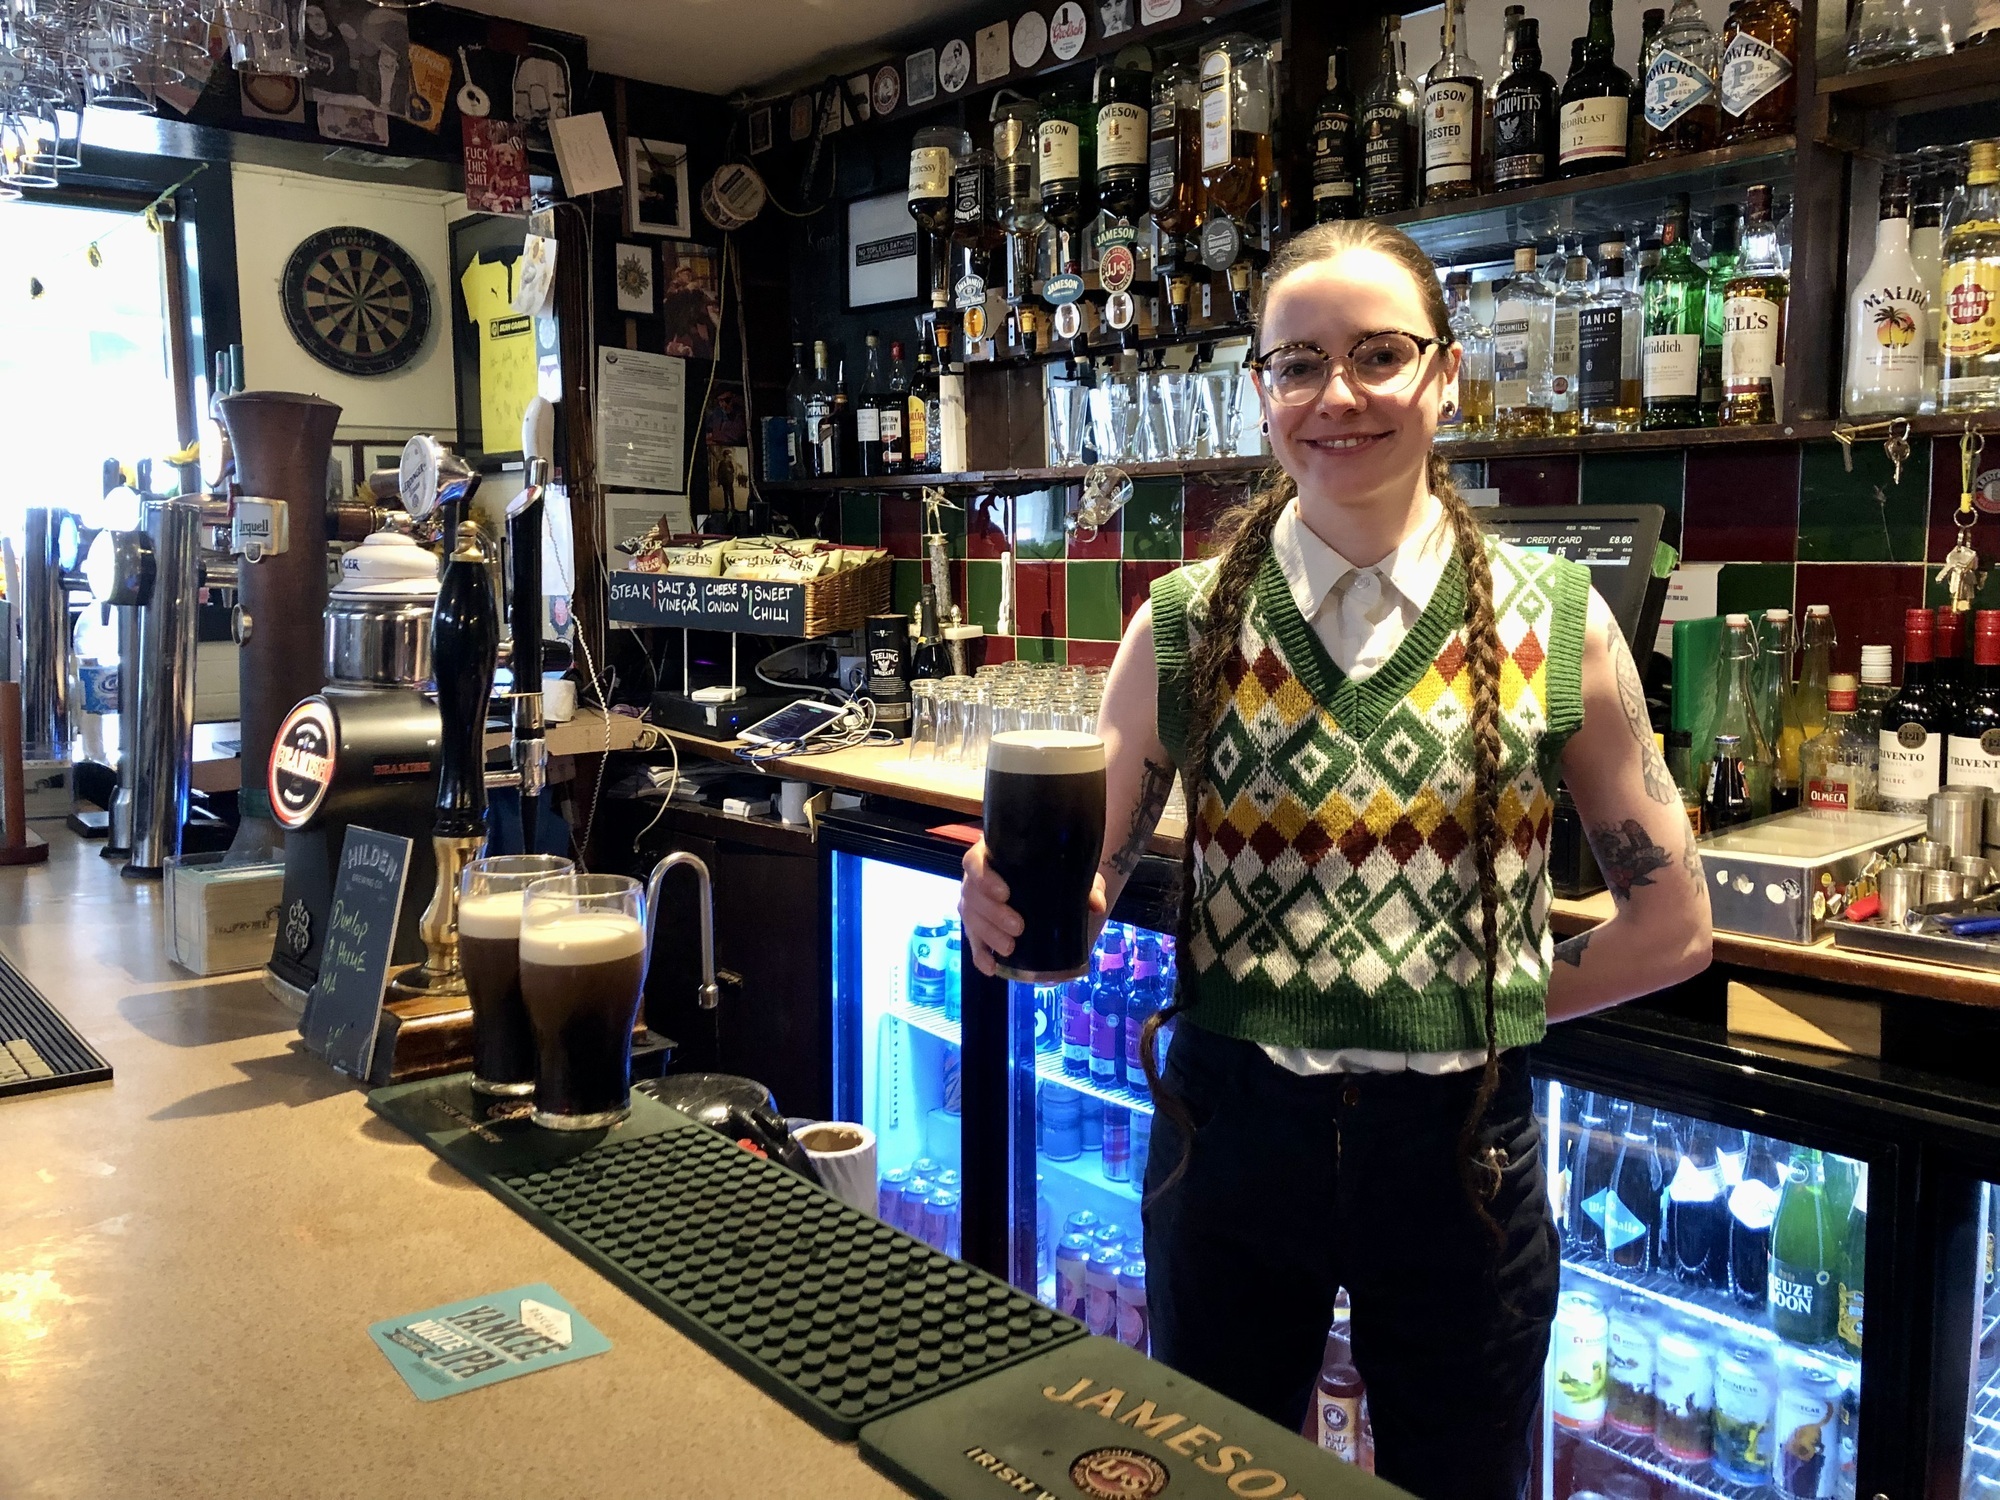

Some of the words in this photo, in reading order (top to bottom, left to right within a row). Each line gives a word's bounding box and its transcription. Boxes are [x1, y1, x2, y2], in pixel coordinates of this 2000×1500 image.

[1052, 18, 1085, 44] Grolsch
[1731, 60, 1755, 90] P
[1426, 90, 1466, 105] AMESON
[1655, 77, 1678, 105] P
[1494, 94, 1541, 119] LACKPITTS
[1100, 107, 1139, 123] AMESON
[1363, 107, 1400, 126] AMESON
[1040, 125, 1069, 138] MESON
[1426, 125, 1461, 141] CRESTED
[1366, 139, 1389, 153] BLACK
[1573, 136, 1583, 146] 12
[465, 147, 488, 160] FUCK
[467, 160, 487, 173] THIS
[911, 164, 936, 174] ennessy
[468, 173, 487, 186] SHIT
[1096, 227, 1135, 246] JAMESON
[867, 244, 889, 255] TOPLESS
[1047, 279, 1079, 295] JAMESON
[1863, 286, 1927, 312] MALIBU
[1950, 305, 1983, 318] Club
[1495, 322, 1528, 333] BUSHMILLS
[1723, 312, 1768, 334] BELL'S
[807, 406, 829, 415] MPARI
[1526, 536, 1557, 544] CREDIT
[1558, 536, 1582, 544] CARD
[1609, 536, 1633, 544] £8.60
[1556, 547, 1566, 557] £5
[610, 583, 651, 600] STEAK
[657, 580, 684, 594] SALT
[706, 583, 737, 596] CHEESE
[754, 586, 794, 601] SWEET
[658, 598, 700, 616] VINEGAR
[707, 601, 739, 613] ONION
[752, 606, 789, 623] CHILLI
[871, 652, 899, 662] TEELING
[874, 668, 895, 676] WHISKEY
[1880, 749, 1925, 762] RIVENTO
[1950, 757, 2000, 768] TRIVENT
[373, 762, 431, 775] BEAMISH
[1811, 790, 1846, 803] OLMECA
[347, 844, 398, 883] HILDEN
[332, 899, 368, 946] Dunlop
[407, 1319, 473, 1351] WHITE
[446, 1305, 569, 1363] YANKEE
[427, 1345, 507, 1380] IPA
[964, 1446, 1035, 1495] IRISH
